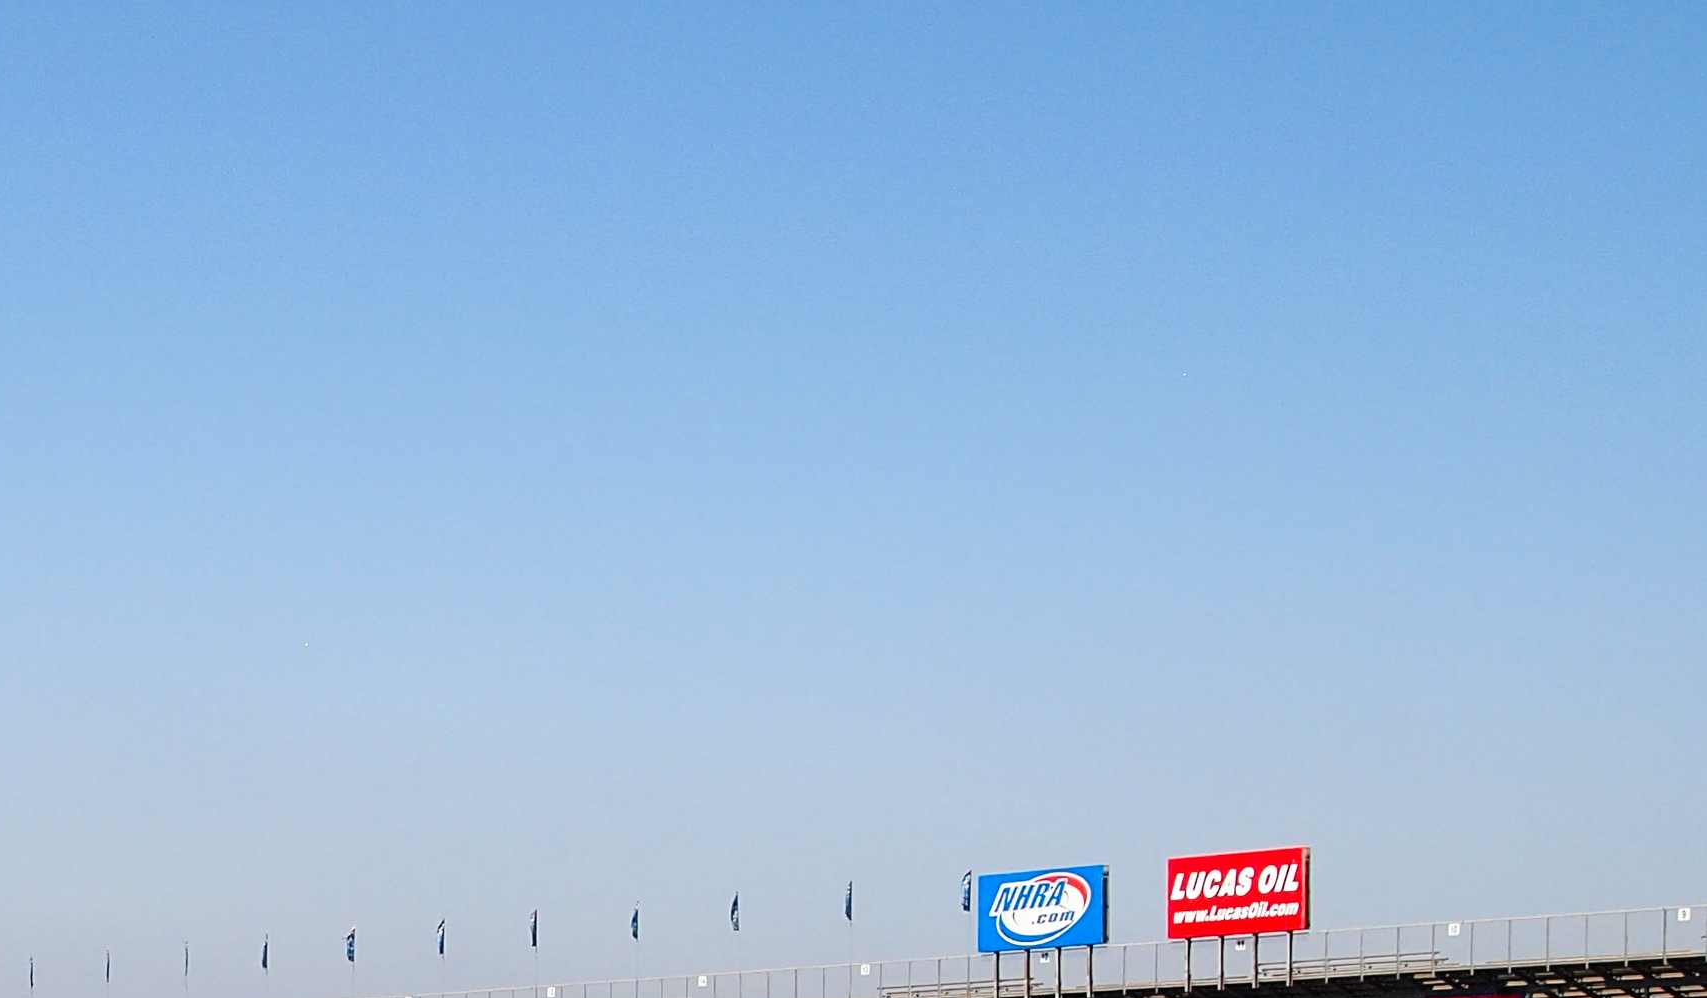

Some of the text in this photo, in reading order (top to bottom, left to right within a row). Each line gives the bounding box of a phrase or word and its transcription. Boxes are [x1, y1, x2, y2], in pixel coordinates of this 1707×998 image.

[1170, 863, 1300, 900] LUCAS OIL
[994, 880, 1066, 913] NHRA
[1031, 911, 1075, 925] .com
[1173, 901, 1300, 924] www.LucasOil.com
